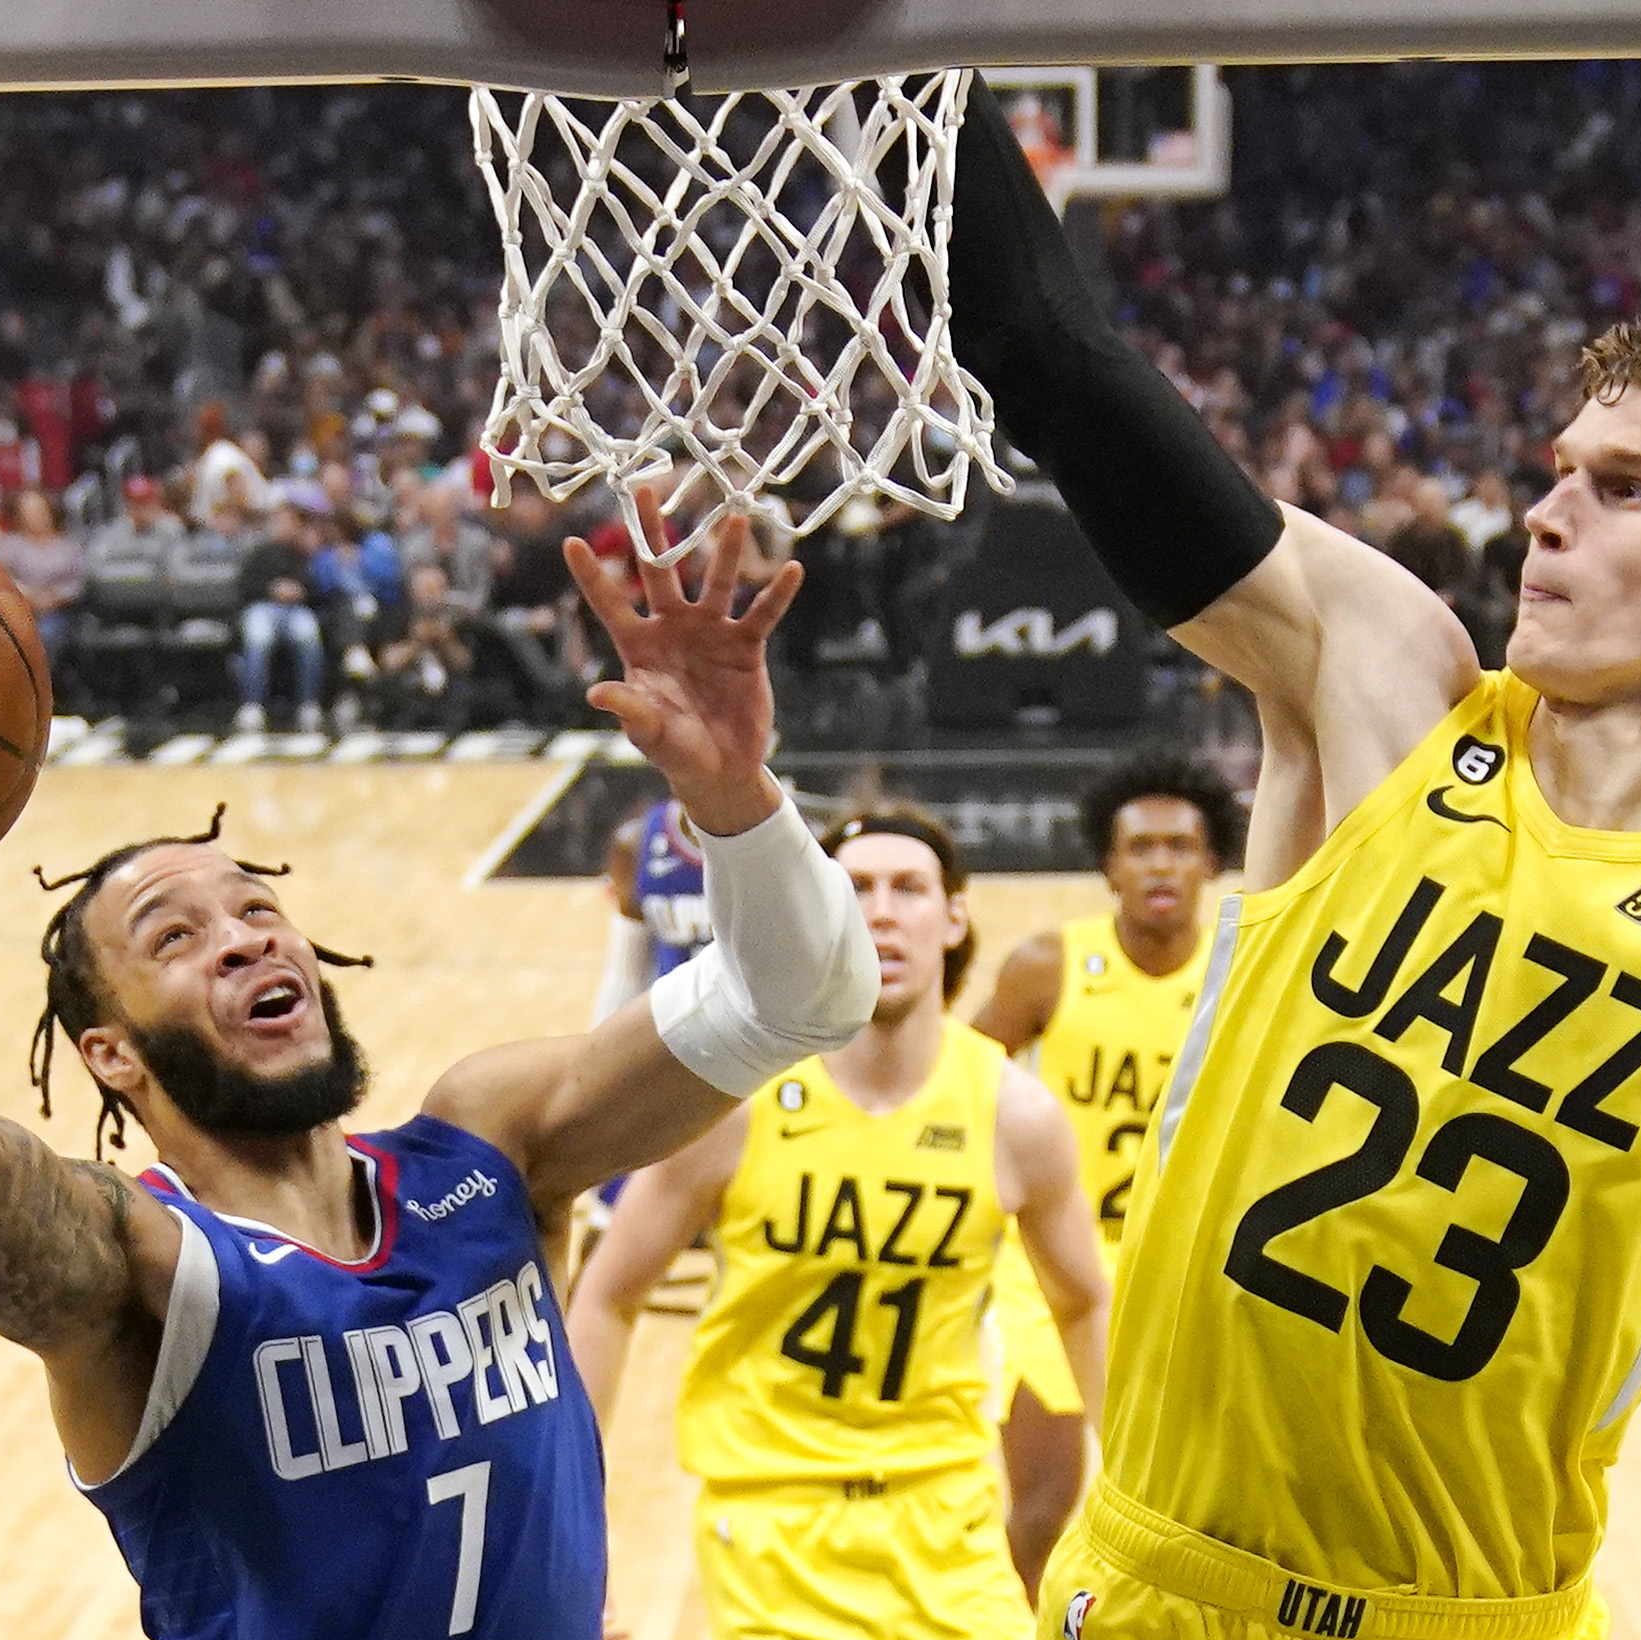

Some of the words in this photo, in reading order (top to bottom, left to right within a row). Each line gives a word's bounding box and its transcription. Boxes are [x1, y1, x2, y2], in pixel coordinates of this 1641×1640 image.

[1457, 744, 1497, 782] 6
[406, 1168, 498, 1222] honey
[764, 1172, 973, 1267] JAZZ
[1224, 1041, 1571, 1382] 23
[252, 1260, 559, 1481] CLIPPERS
[781, 1270, 928, 1401] 41
[426, 1460, 492, 1637] 7
[1277, 1578, 1368, 1640] UTAH
